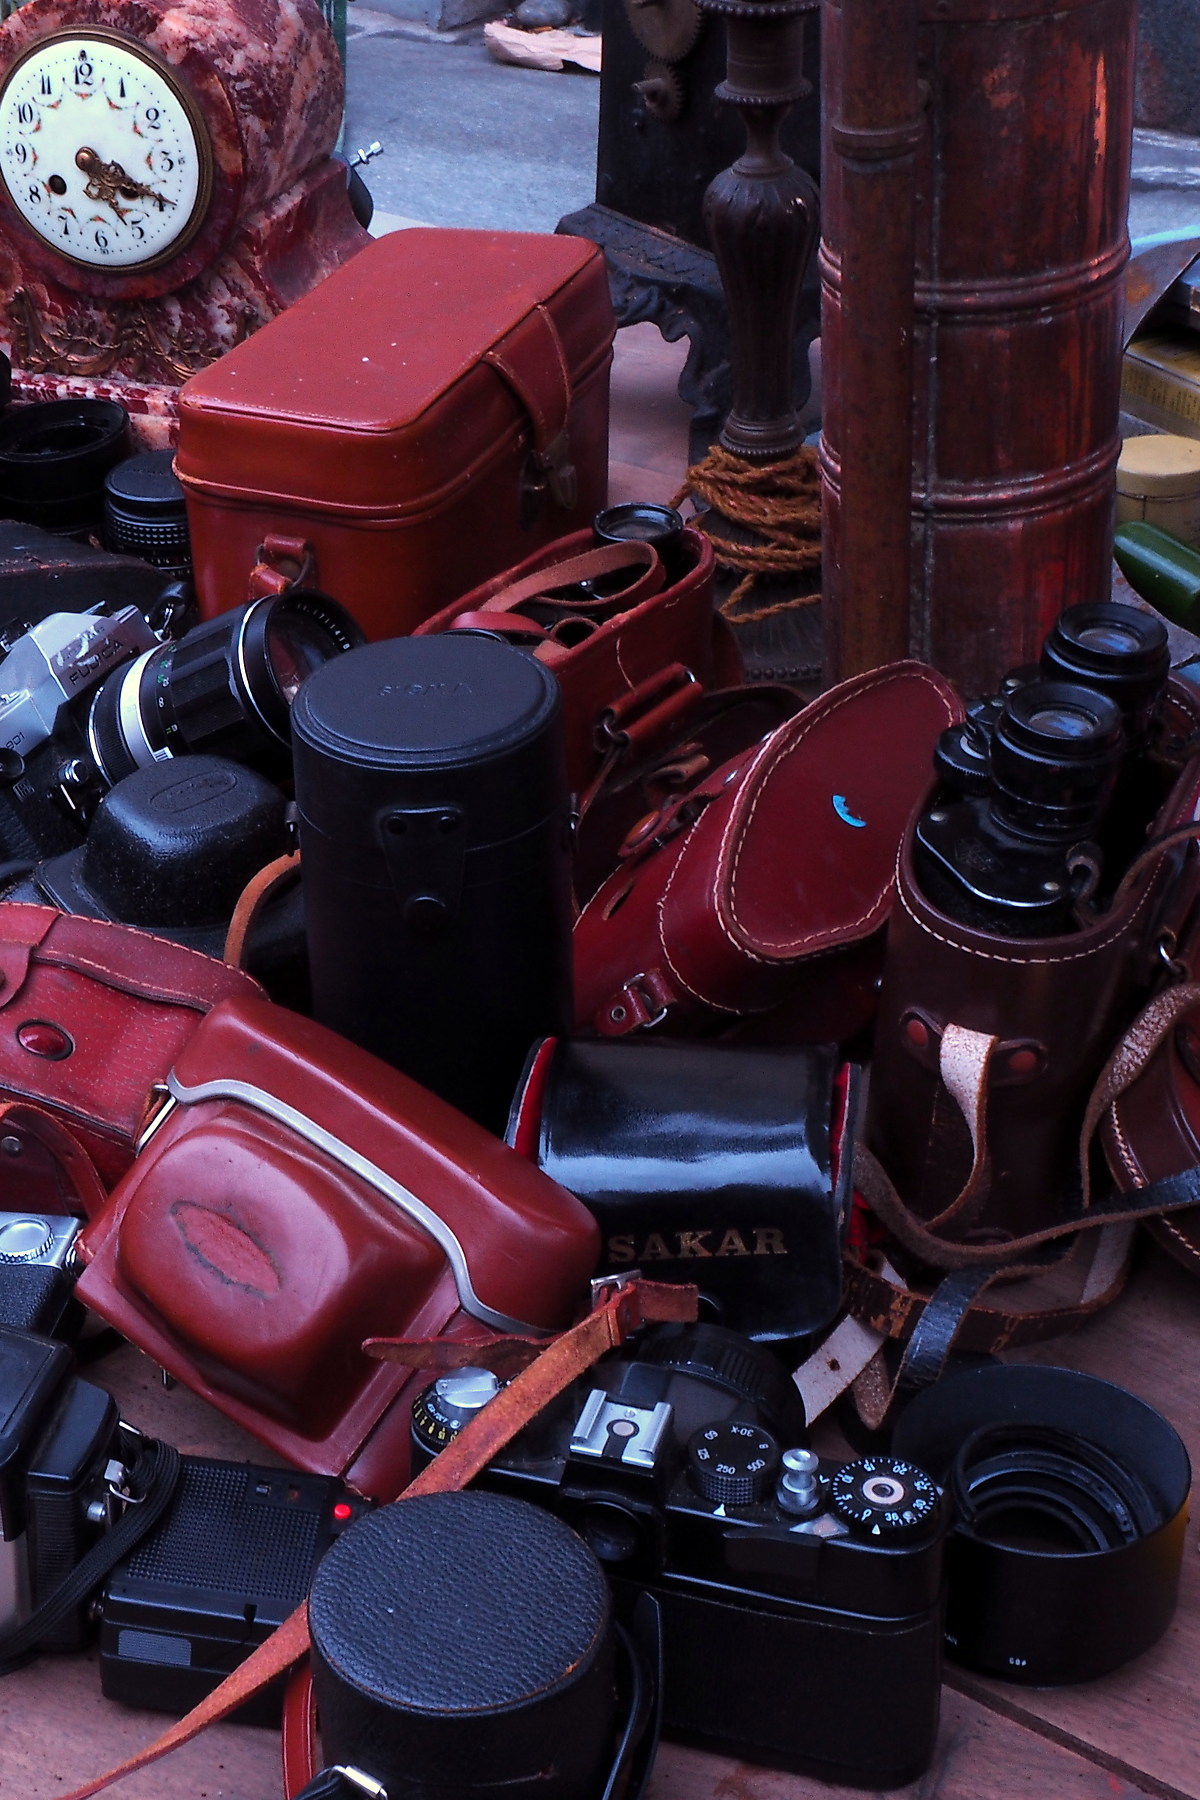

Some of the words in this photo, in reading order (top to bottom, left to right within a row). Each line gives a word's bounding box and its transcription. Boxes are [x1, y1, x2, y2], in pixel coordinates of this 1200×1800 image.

[73, 63, 94, 86] 12
[41, 75, 52, 95] 11
[119, 77, 126, 98] 1
[17, 103, 33, 124] 10
[145, 108, 160, 130] 2
[15, 143, 27, 164] 9
[160, 151, 174, 172] 3
[29, 184, 42, 204] 8
[58, 215, 70, 235] 7
[130, 215, 145, 239] 5
[95, 230, 108, 248] 6
[69, 640, 124, 686] FUJICA
[607, 1227, 788, 1264] SAKAR
[704, 1430, 719, 1440] 60
[697, 1447, 710, 1460] 125
[715, 1463, 736, 1475] 250
[746, 1459, 766, 1472] 500
[863, 1463, 876, 1472] 15
[892, 1465, 908, 1475] 20
[841, 1474, 854, 1483] 10
[914, 1480, 928, 1491] 25
[913, 1499, 927, 1510] 30
